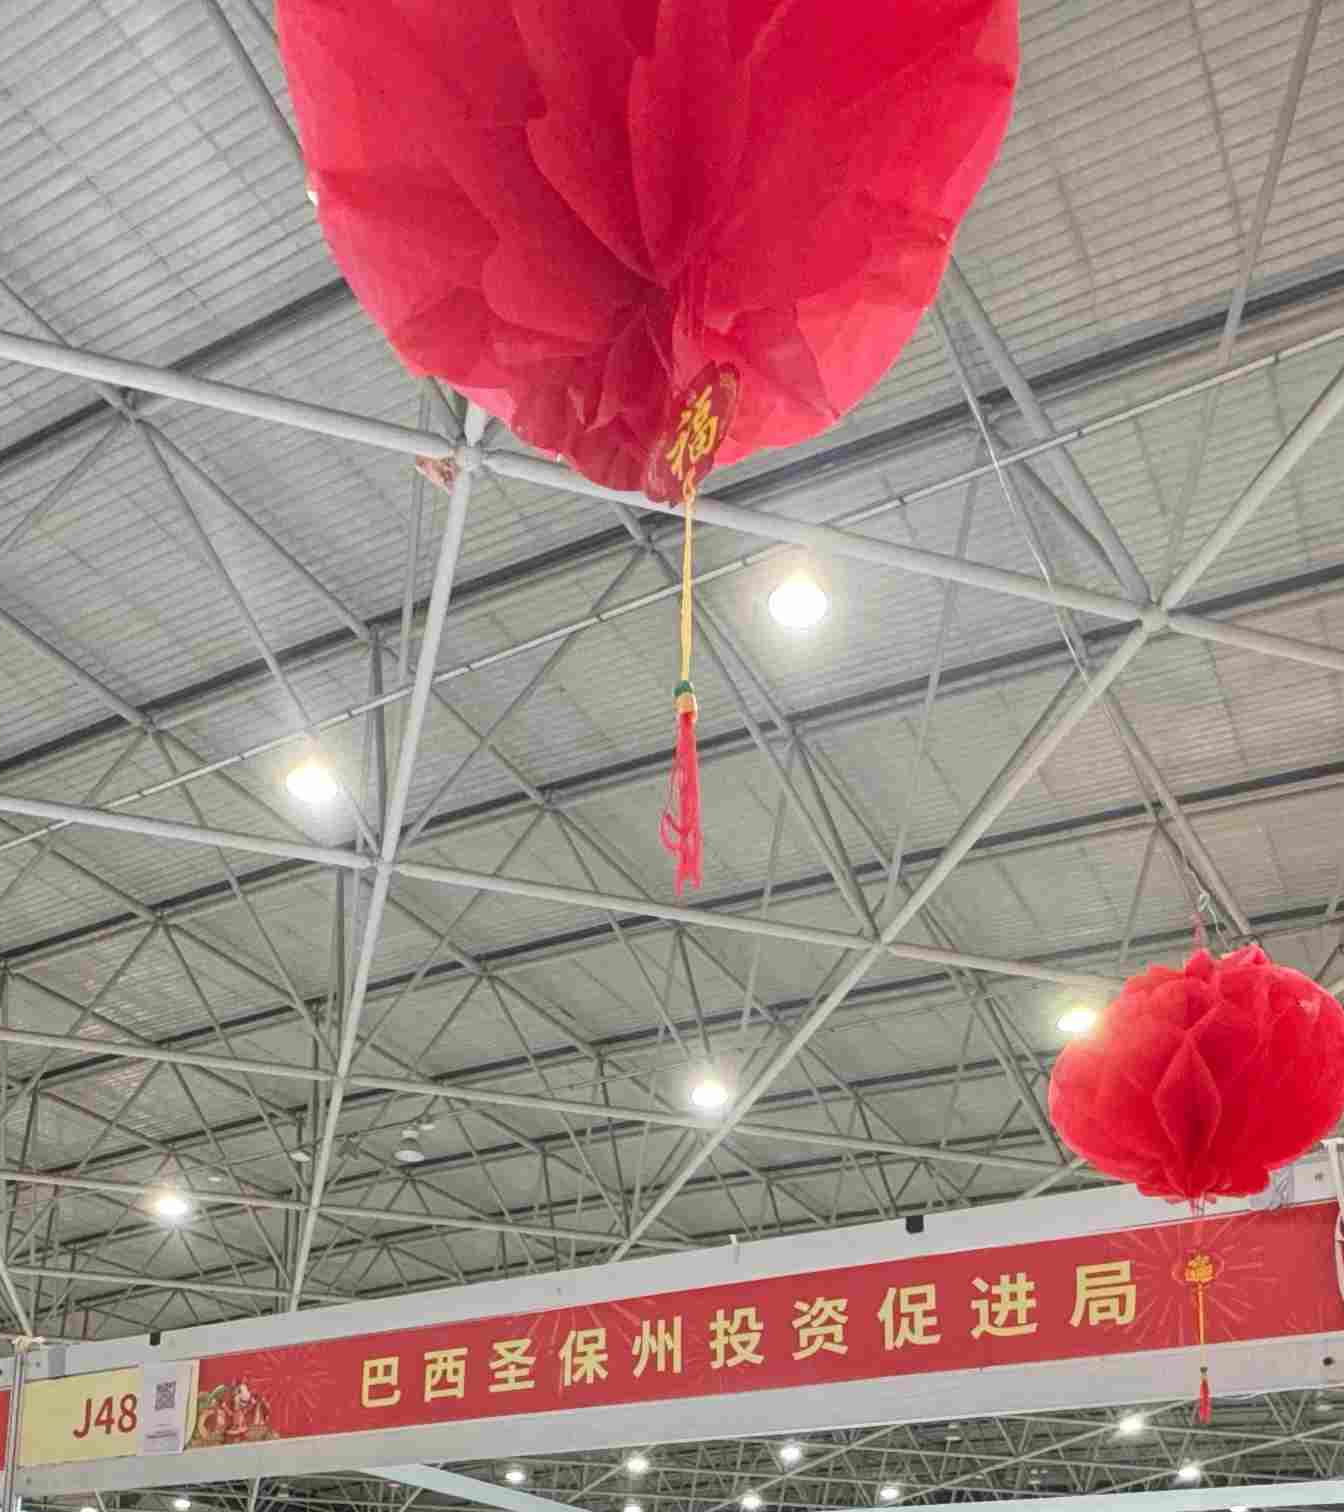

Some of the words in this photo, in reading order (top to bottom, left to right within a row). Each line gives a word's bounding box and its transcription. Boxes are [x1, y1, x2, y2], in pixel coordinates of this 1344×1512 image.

[360, 1259, 1138, 1409] 巴西圣保州投资促进局
[73, 1393, 138, 1440] J48
